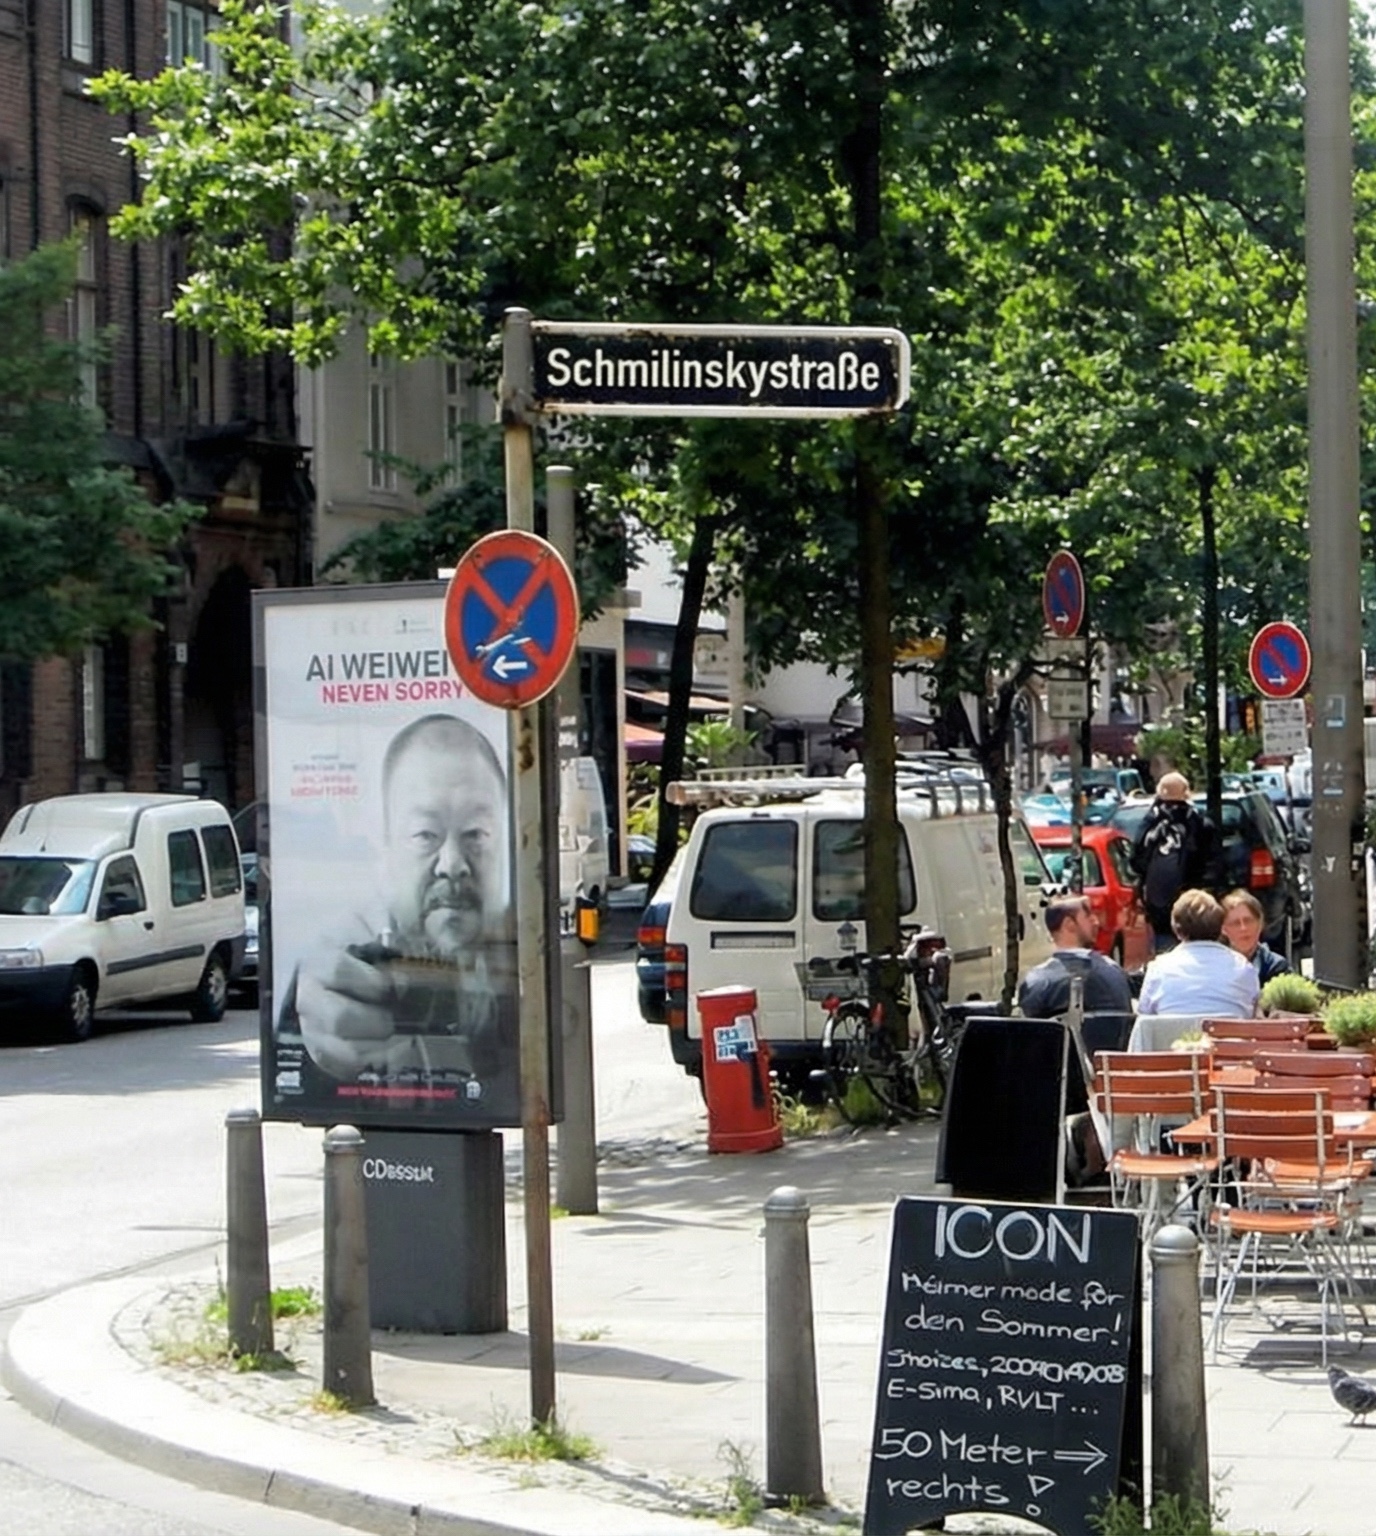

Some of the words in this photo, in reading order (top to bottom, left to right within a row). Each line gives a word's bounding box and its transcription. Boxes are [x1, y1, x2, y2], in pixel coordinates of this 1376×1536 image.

[546, 347, 880, 398] Schmilinskystraße
[305, 653, 333, 682] AI
[340, 650, 449, 681] WEIWEI
[321, 681, 390, 704] NEVEN
[934, 1204, 1092, 1264] ICON
[904, 1302, 965, 1333] den
[873, 1427, 932, 1460] 50
[940, 1428, 1049, 1467] Meter
